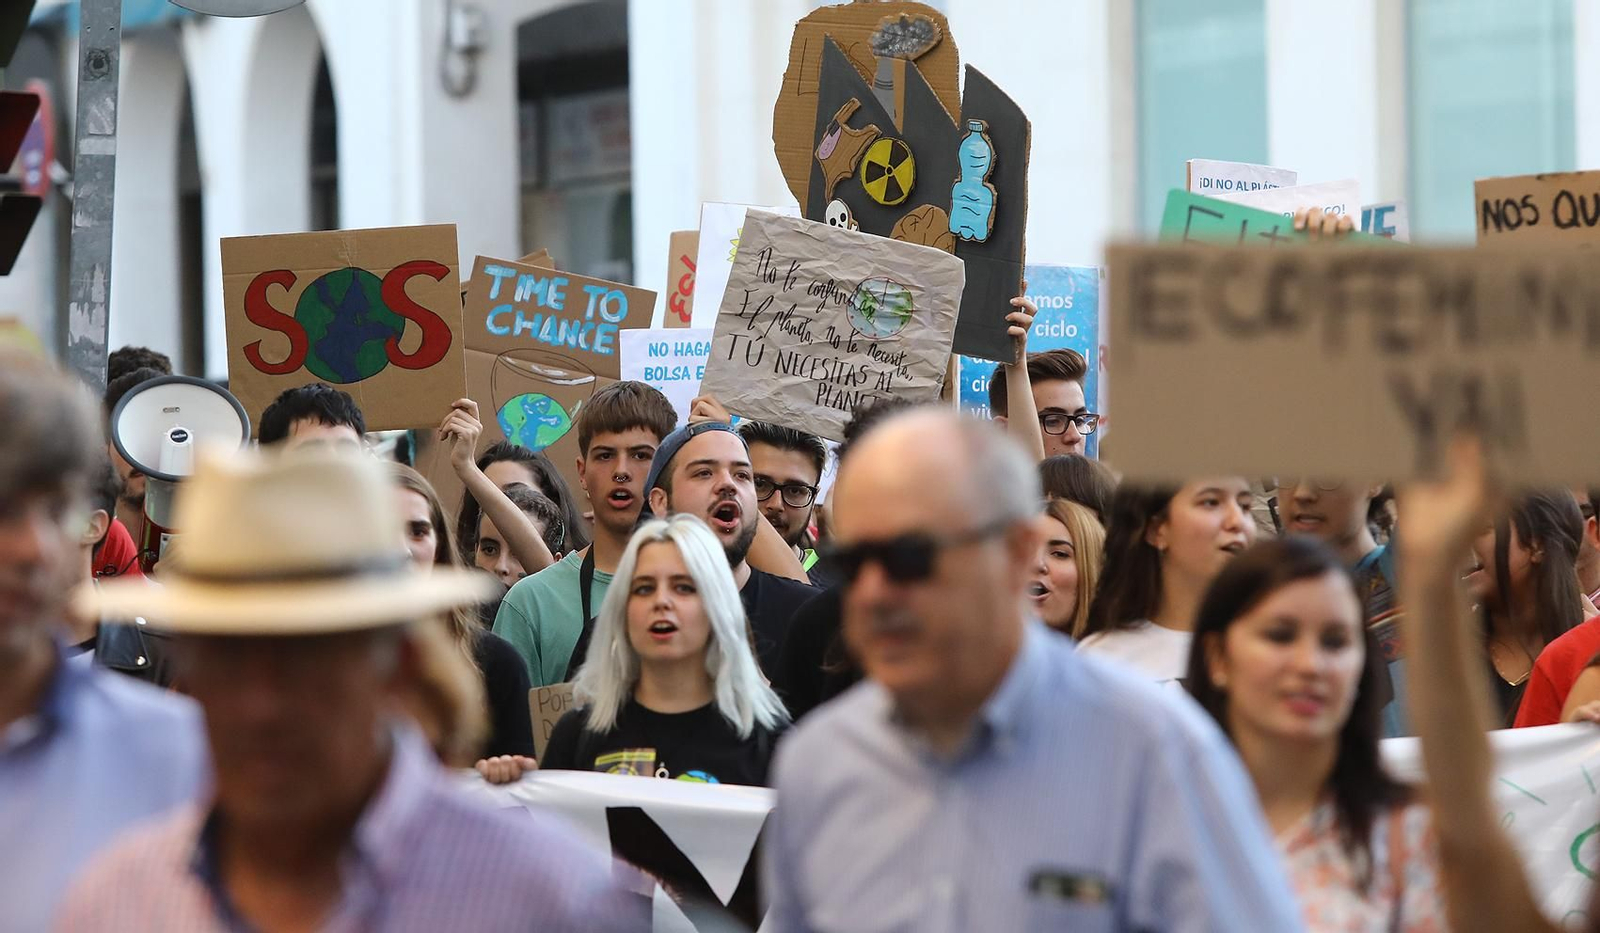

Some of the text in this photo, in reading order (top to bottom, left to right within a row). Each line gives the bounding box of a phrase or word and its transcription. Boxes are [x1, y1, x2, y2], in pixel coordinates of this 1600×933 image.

[1216, 179, 1233, 190] NO
[1236, 180, 1249, 192] AL
[1483, 194, 1540, 235] NOS
[756, 247, 777, 284] No
[783, 260, 801, 293] te
[484, 264, 629, 323] TIME TO
[243, 259, 453, 384] SOS
[826, 325, 841, 349] no
[1035, 320, 1077, 337] ciclo
[649, 342, 669, 357] NO
[728, 333, 766, 367] TÚ
[874, 371, 893, 393] AL
[644, 366, 691, 381] BOLSA
